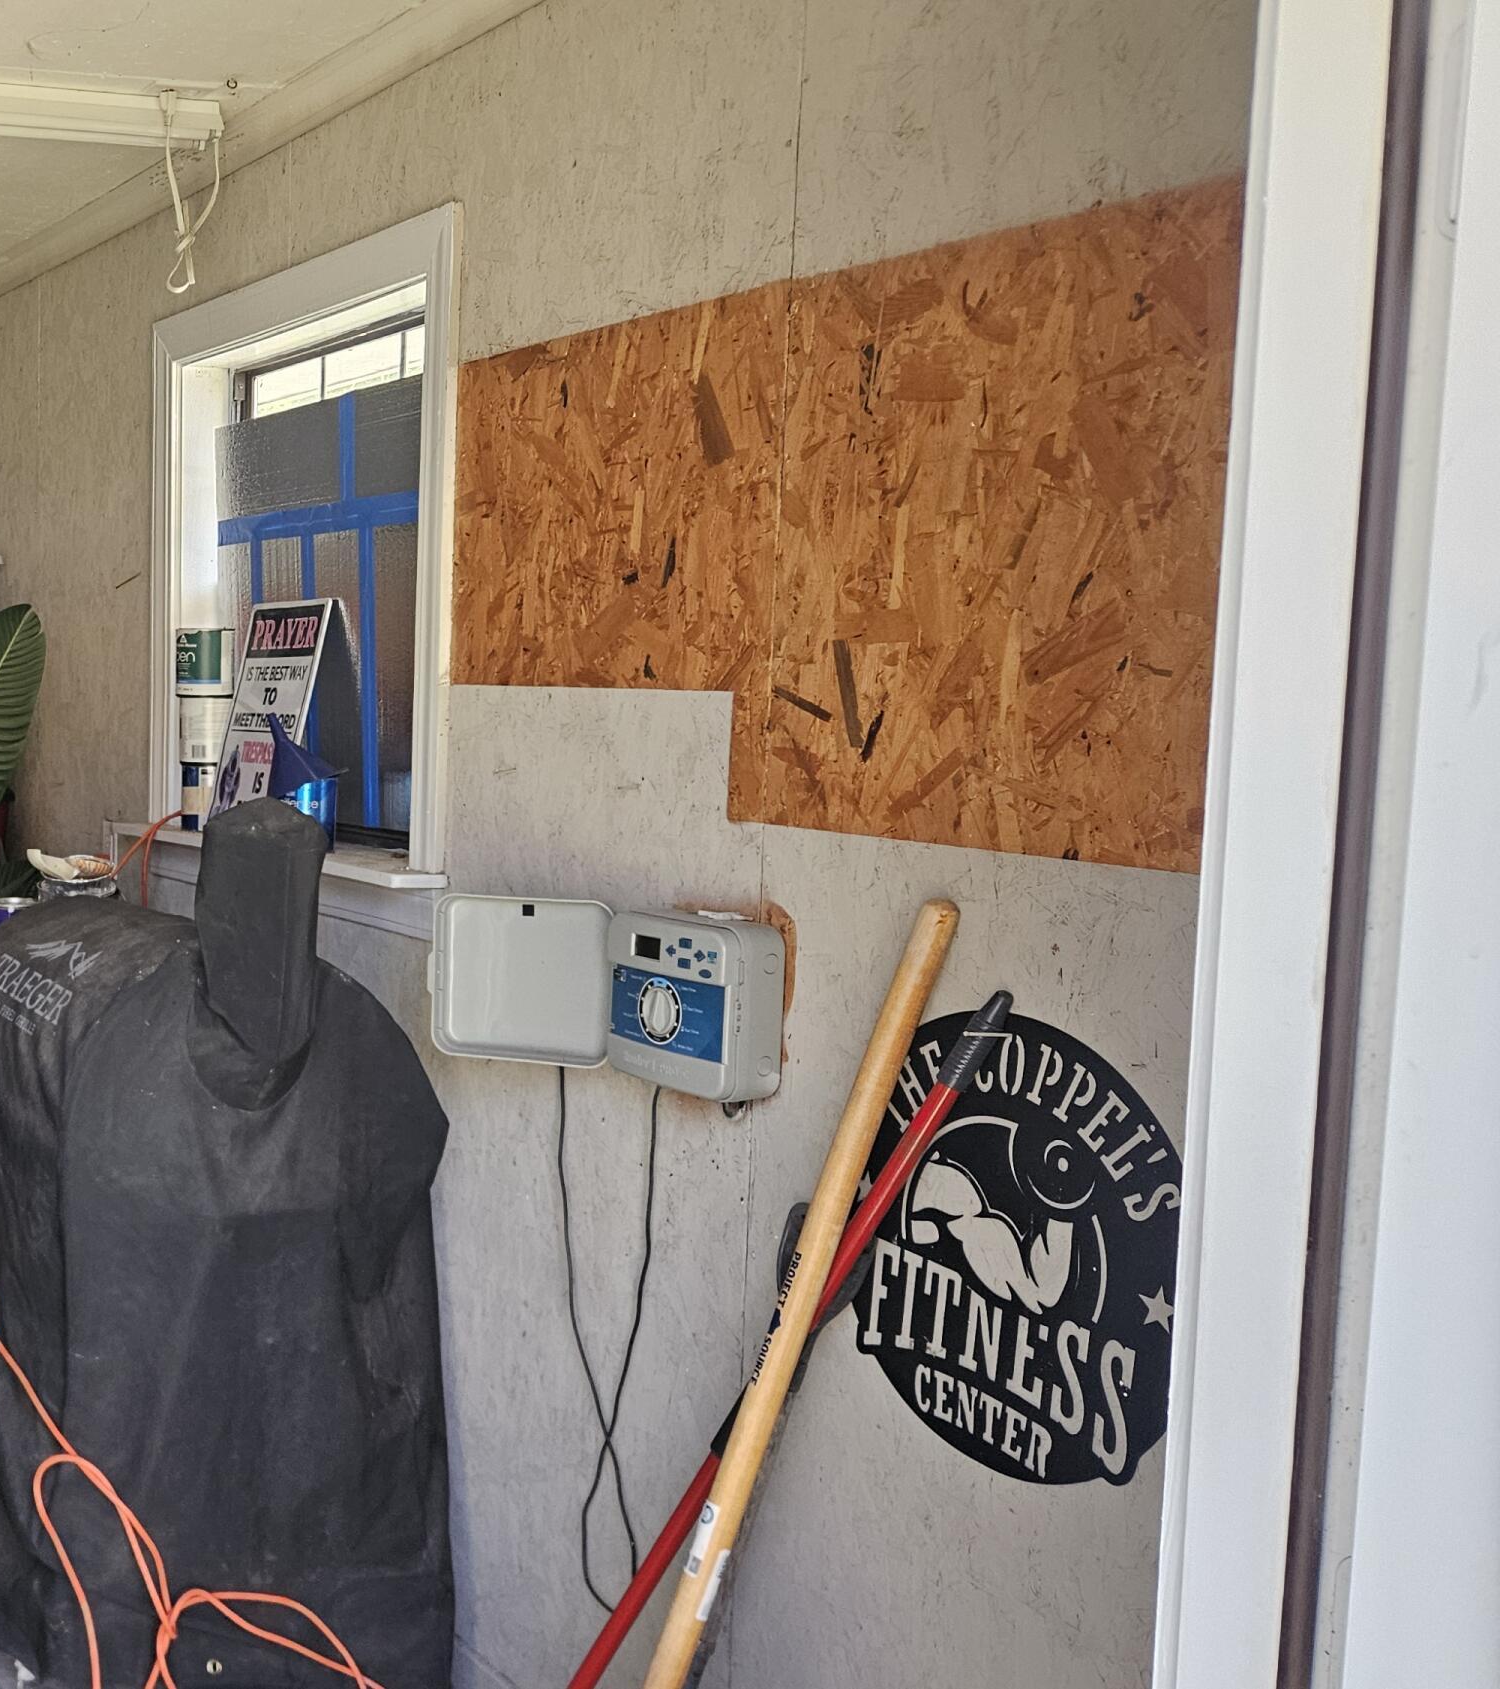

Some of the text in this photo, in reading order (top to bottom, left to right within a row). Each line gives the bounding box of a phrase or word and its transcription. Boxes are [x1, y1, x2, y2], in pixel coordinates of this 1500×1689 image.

[251, 616, 319, 650] PRAYER
[246, 665, 308, 681] IS THE BEST WAY
[263, 687, 278, 705] TO
[233, 712, 255, 728] MEET
[276, 714, 296, 729] ORD
[241, 741, 275, 764] TRESPAS
[252, 771, 264, 794] IS
[863, 1236, 1136, 1475] FITNESS
[914, 1363, 1052, 1478] CENTER
